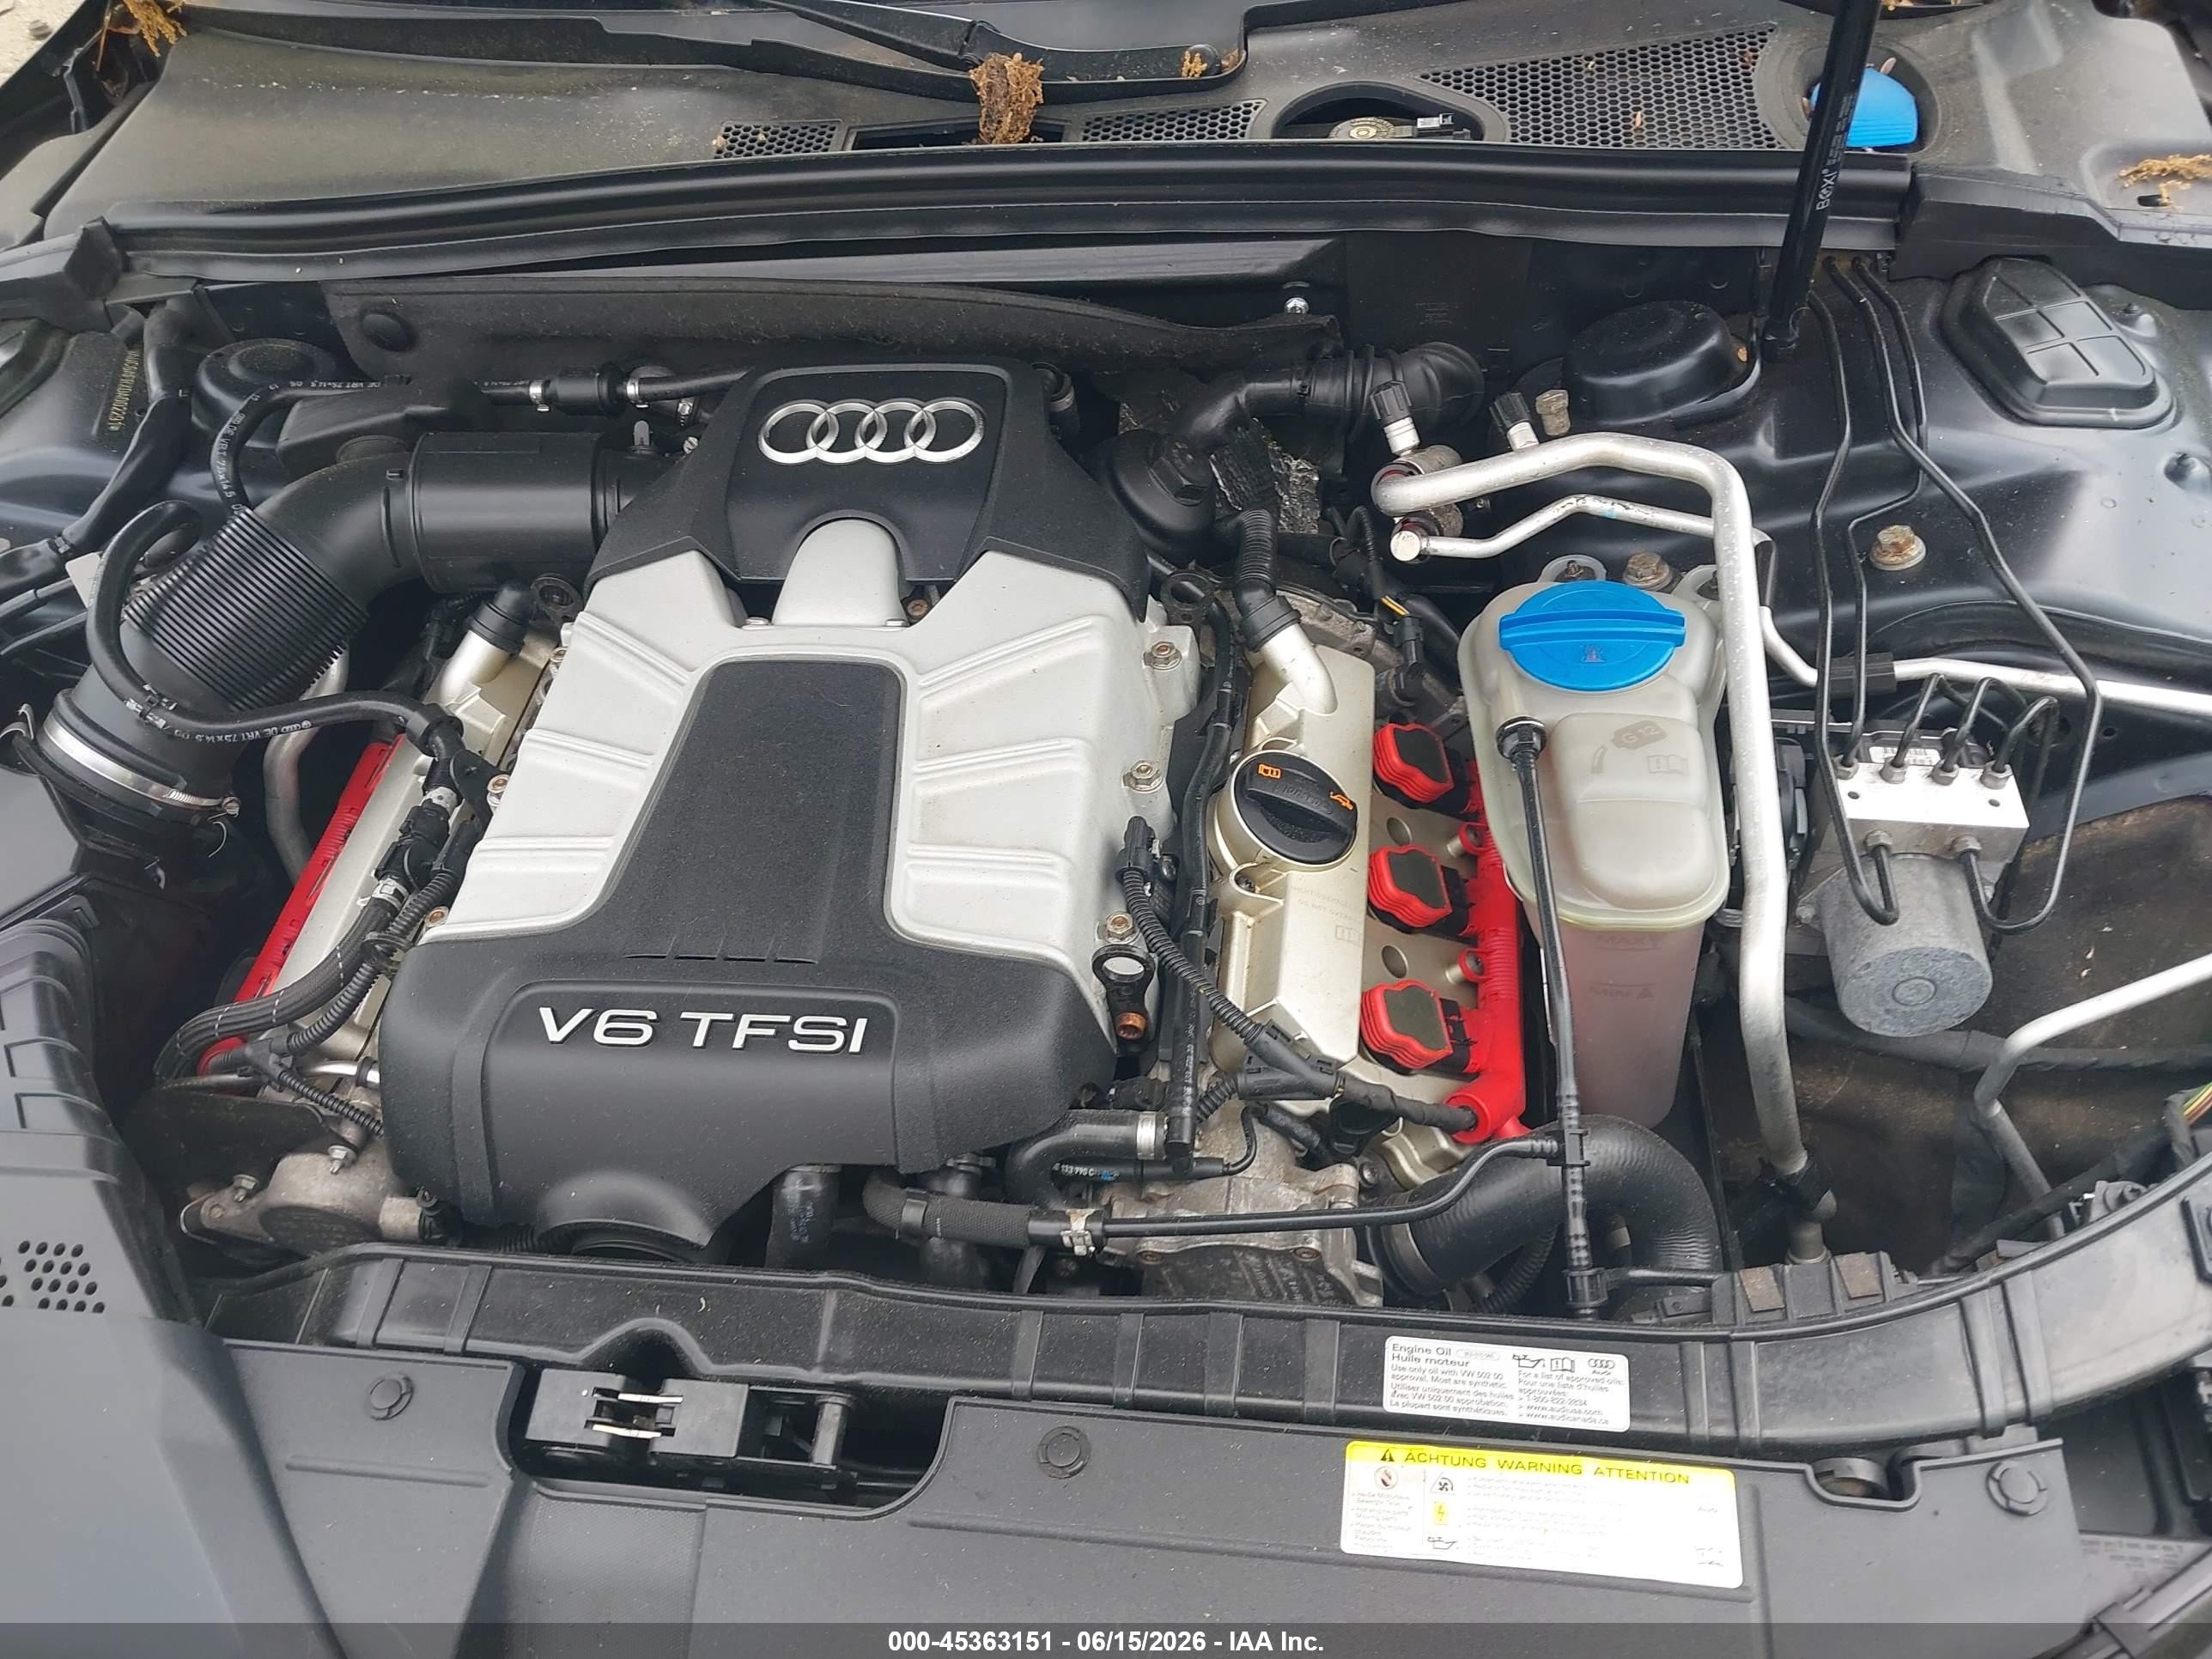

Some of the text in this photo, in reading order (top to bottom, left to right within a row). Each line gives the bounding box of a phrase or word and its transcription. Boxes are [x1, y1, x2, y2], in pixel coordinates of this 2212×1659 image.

[241, 731, 260, 741] VRT
[264, 726, 278, 737] DE
[539, 1006, 868, 1053] V6 TFSI
[1391, 1343, 1431, 1356] Engine
[1435, 1346, 1452, 1357] Oil
[1391, 1352, 1470, 1368] Huile moteur
[1404, 1451, 1691, 1486] ACHTUNG WARNING ATTENTION
